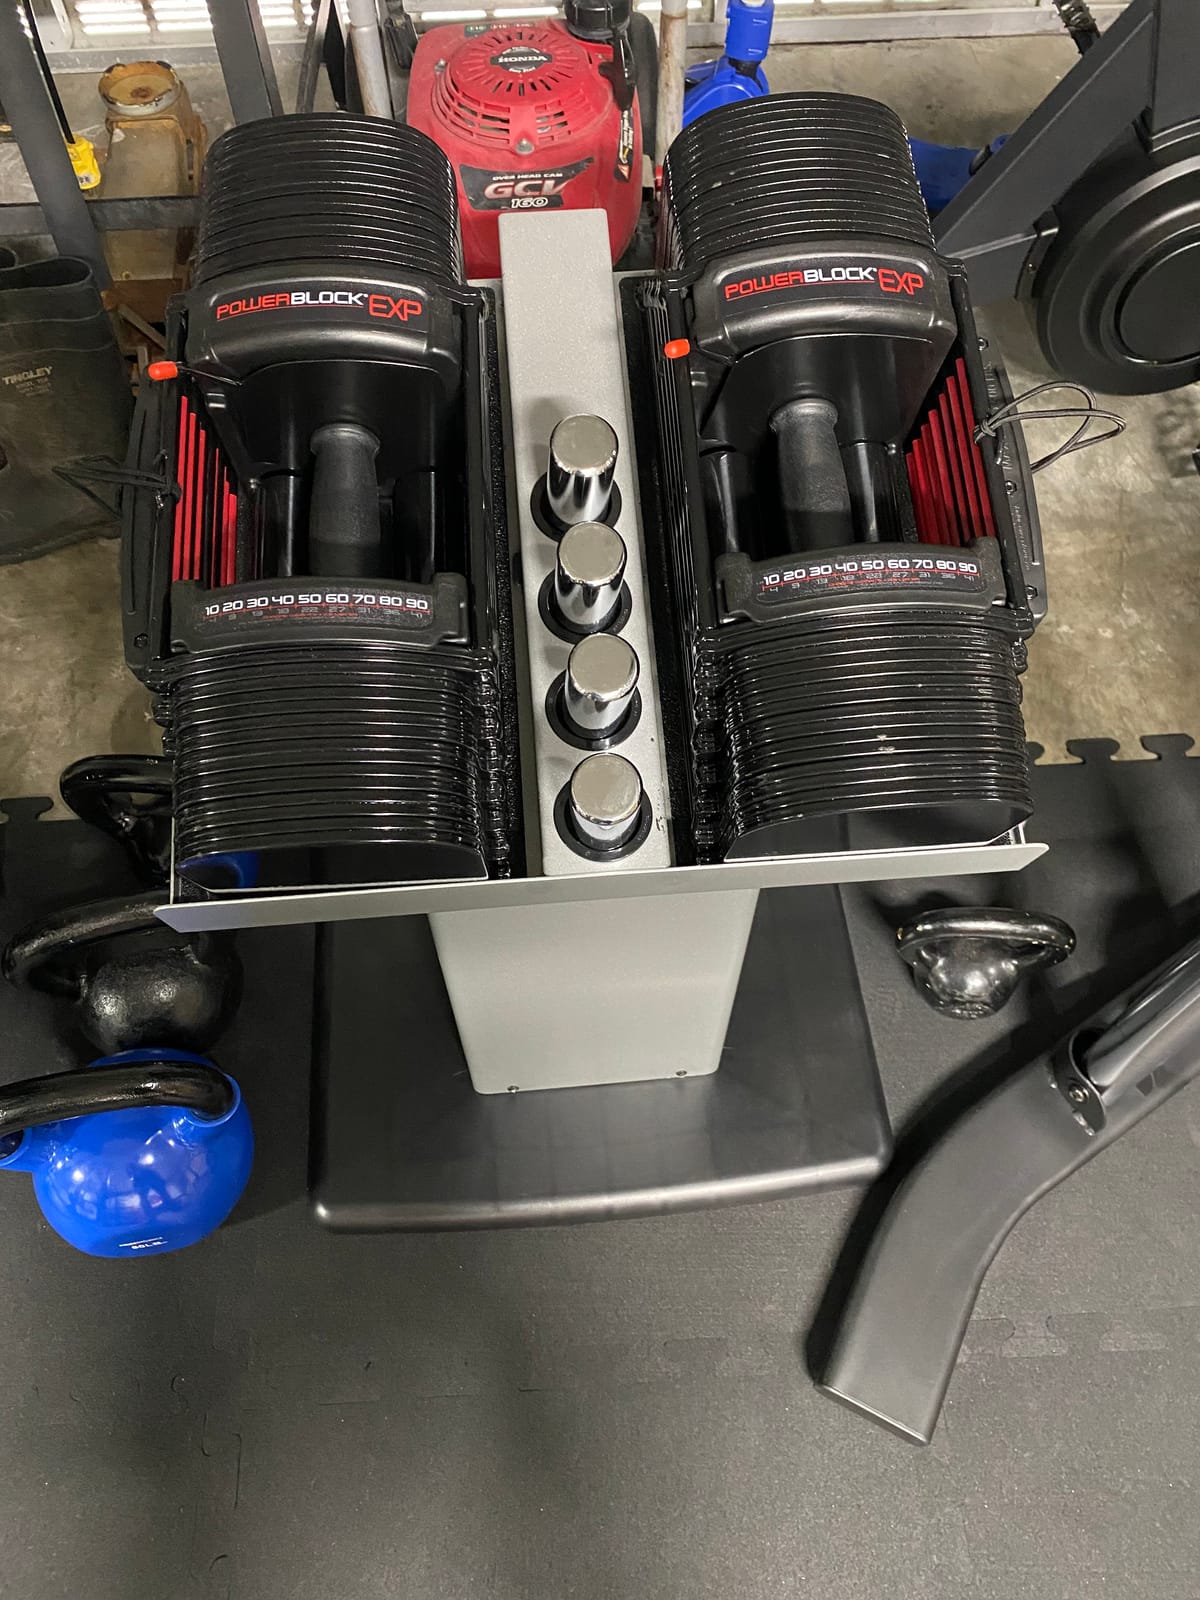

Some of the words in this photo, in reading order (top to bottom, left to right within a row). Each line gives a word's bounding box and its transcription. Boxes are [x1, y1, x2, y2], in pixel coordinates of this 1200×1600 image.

[484, 180, 567, 199] GCV
[511, 197, 549, 209] 160
[724, 267, 875, 299] POWERBLOCK
[877, 268, 924, 295] EXP
[216, 291, 365, 319] POWERBLOCK
[368, 294, 423, 321] EXP
[2, 366, 53, 385] TINGLEY
[763, 574, 780, 586] 10
[783, 568, 806, 581] 20
[809, 564, 833, 577] 30
[835, 561, 858, 572] 40
[861, 560, 884, 571] 50
[888, 559, 910, 569] 60
[911, 559, 934, 569] 70
[936, 560, 957, 571] 80
[958, 561, 978, 573] 90
[205, 604, 220, 616] 10
[222, 600, 244, 612] 20
[246, 597, 269, 609] 30
[271, 595, 294, 605] 40
[298, 593, 322, 604] 50
[325, 593, 349, 604] 60
[352, 594, 376, 605] 70
[379, 595, 402, 607] 80
[405, 598, 428, 610] 90
